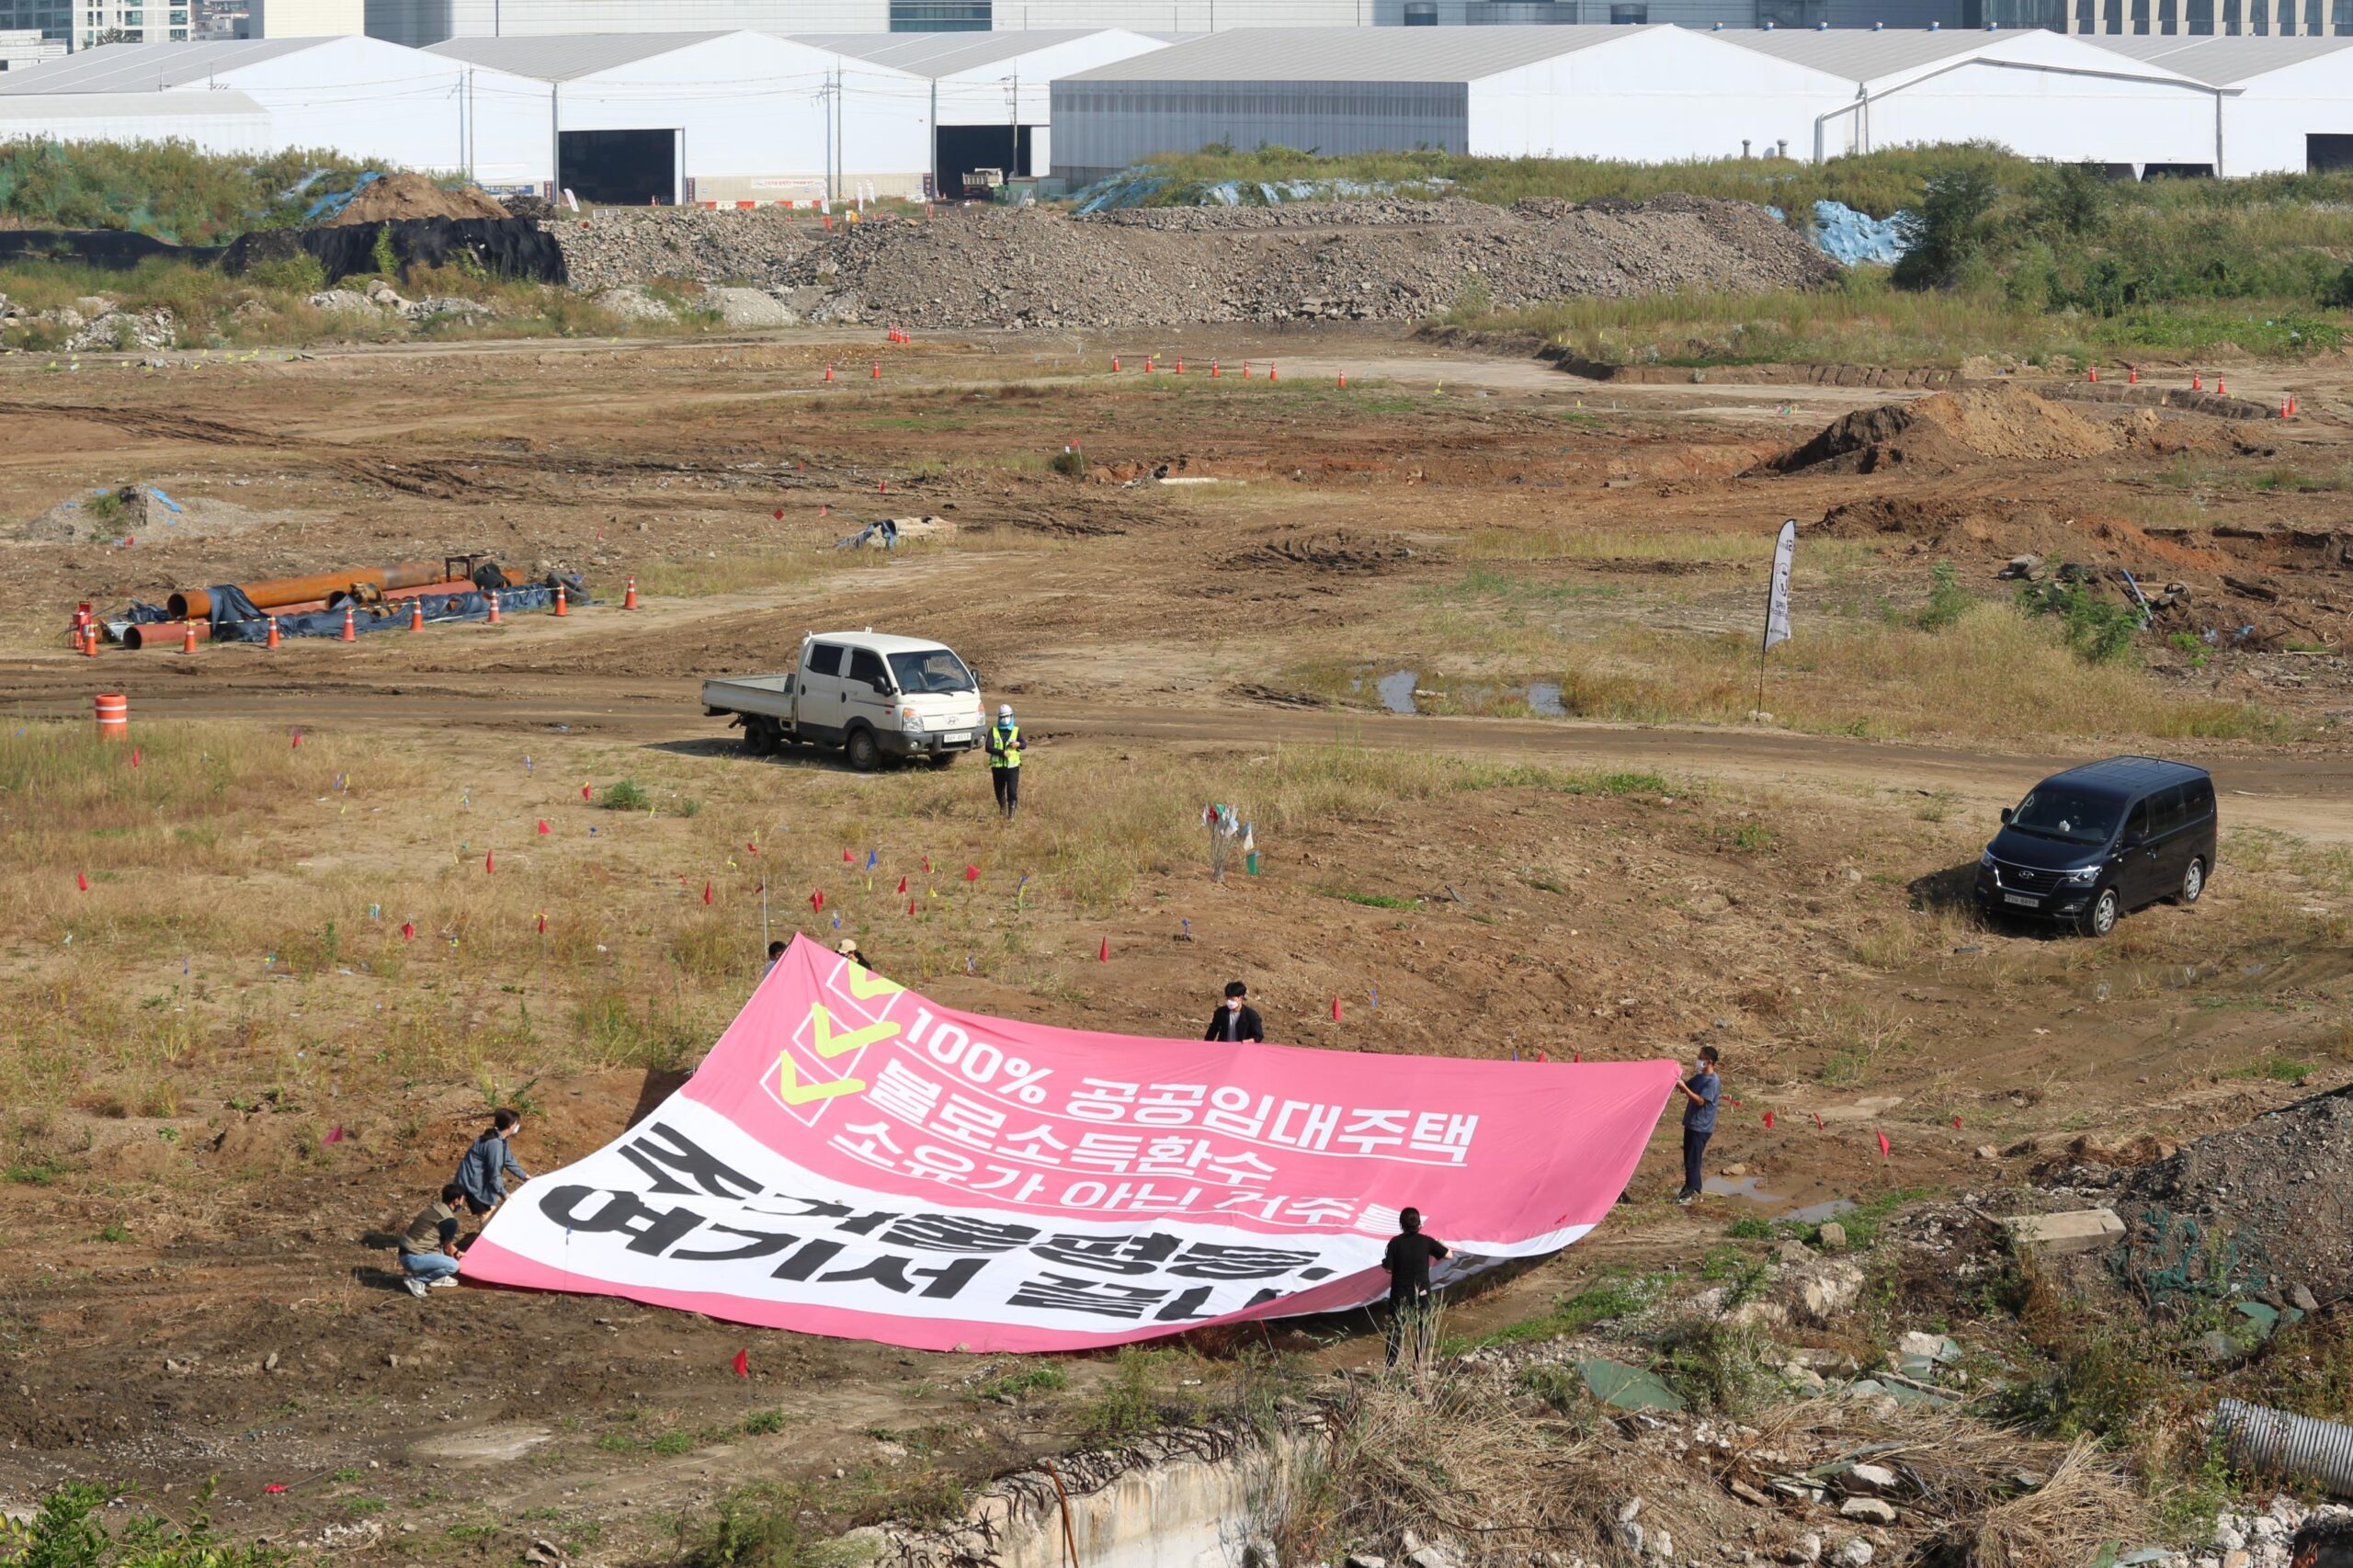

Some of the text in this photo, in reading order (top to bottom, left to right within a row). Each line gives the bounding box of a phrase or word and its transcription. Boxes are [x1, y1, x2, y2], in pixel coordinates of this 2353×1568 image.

[868, 1058, 1278, 1185] 불로소득환수
[906, 1006, 1478, 1164] 100% 공공임대주택
[833, 1121, 1045, 1202] 소유가
[1059, 1181, 1202, 1210] 아닌
[539, 1184, 991, 1300] 여기서
